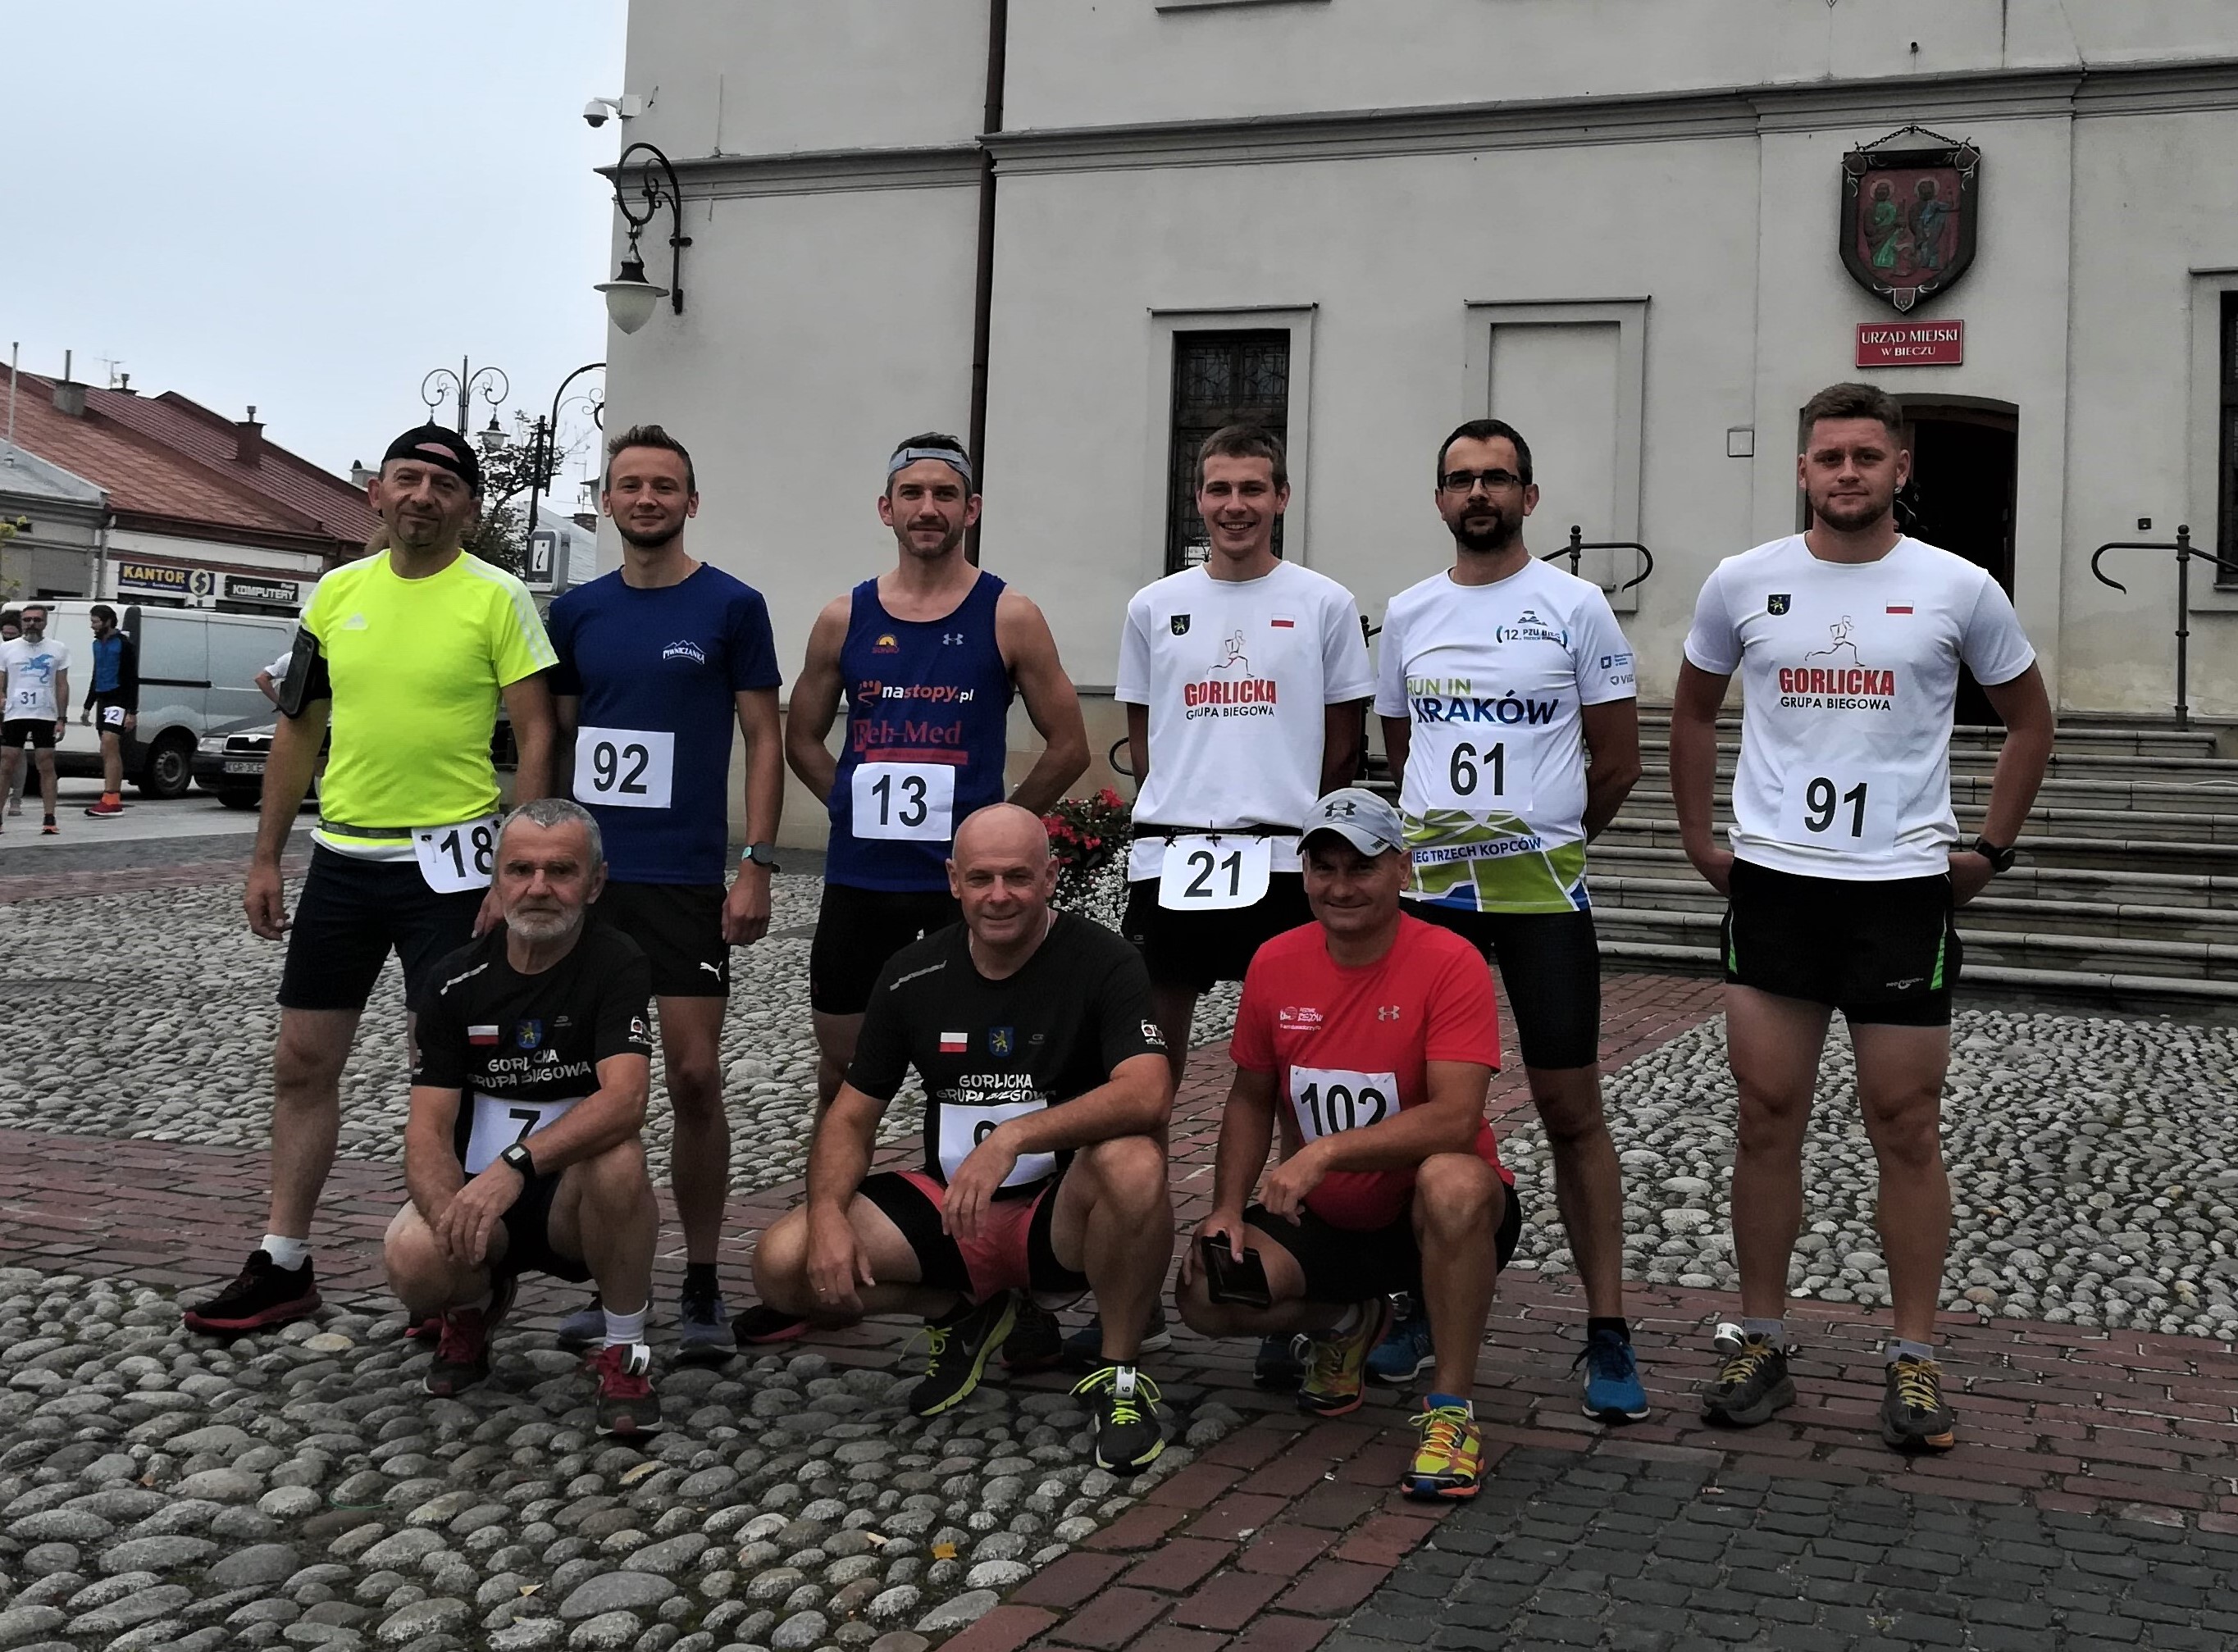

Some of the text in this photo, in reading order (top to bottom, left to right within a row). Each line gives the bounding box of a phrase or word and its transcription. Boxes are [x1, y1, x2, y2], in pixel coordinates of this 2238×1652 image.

[1862, 329, 1958, 345] URZĄD MIEJSKI
[1881, 346, 1936, 357] W BIECZU
[123, 565, 185, 584] KANTOR
[232, 584, 295, 600] KOMPUTERY
[1523, 628, 1540, 636] PZU
[1184, 679, 1277, 707] GORLICKA
[1407, 678, 1471, 697] RUN IN
[1779, 667, 1895, 696] GORLICKA
[21, 691, 37, 705] 31
[882, 684, 974, 703] nastopy.pl
[1780, 696, 1891, 711] GRUPA BIEGOWA
[1223, 705, 1275, 717] BIEGOWA
[1411, 689, 1559, 725] KRAKÓW
[593, 741, 650, 794] 92
[1449, 741, 1506, 797] 61
[871, 774, 928, 827] 13
[1804, 776, 1867, 838] 91
[440, 825, 495, 878] 18
[1412, 836, 1542, 863] IEG TRZECH KOPCÓW
[1183, 850, 1242, 898] 21
[487, 1049, 559, 1072] GORLCKA
[959, 1073, 1033, 1089] GORLICKA
[937, 1088, 984, 1102] GRUPA
[1300, 1082, 1388, 1137] 102
[508, 1108, 541, 1145] 7
